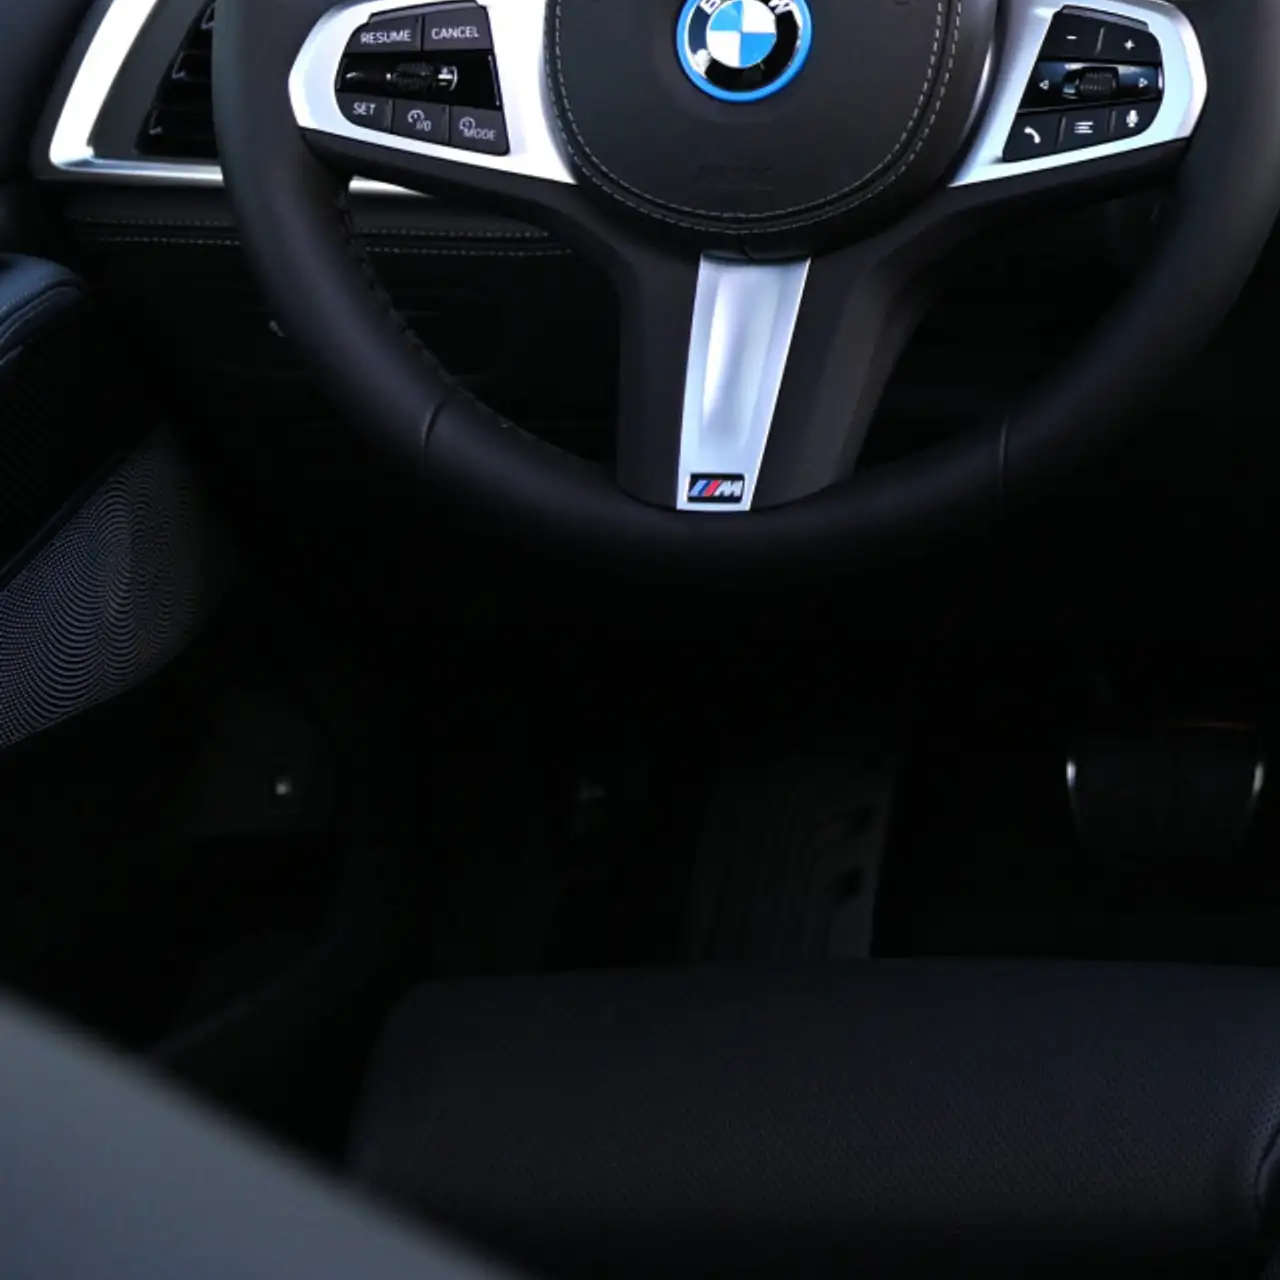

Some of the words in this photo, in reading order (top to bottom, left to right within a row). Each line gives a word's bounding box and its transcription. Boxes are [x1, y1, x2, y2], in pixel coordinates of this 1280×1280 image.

[360, 30, 412, 44] RESUME
[431, 26, 480, 39] CANCEL
[352, 102, 376, 116] SET
[463, 127, 496, 141] MODE
